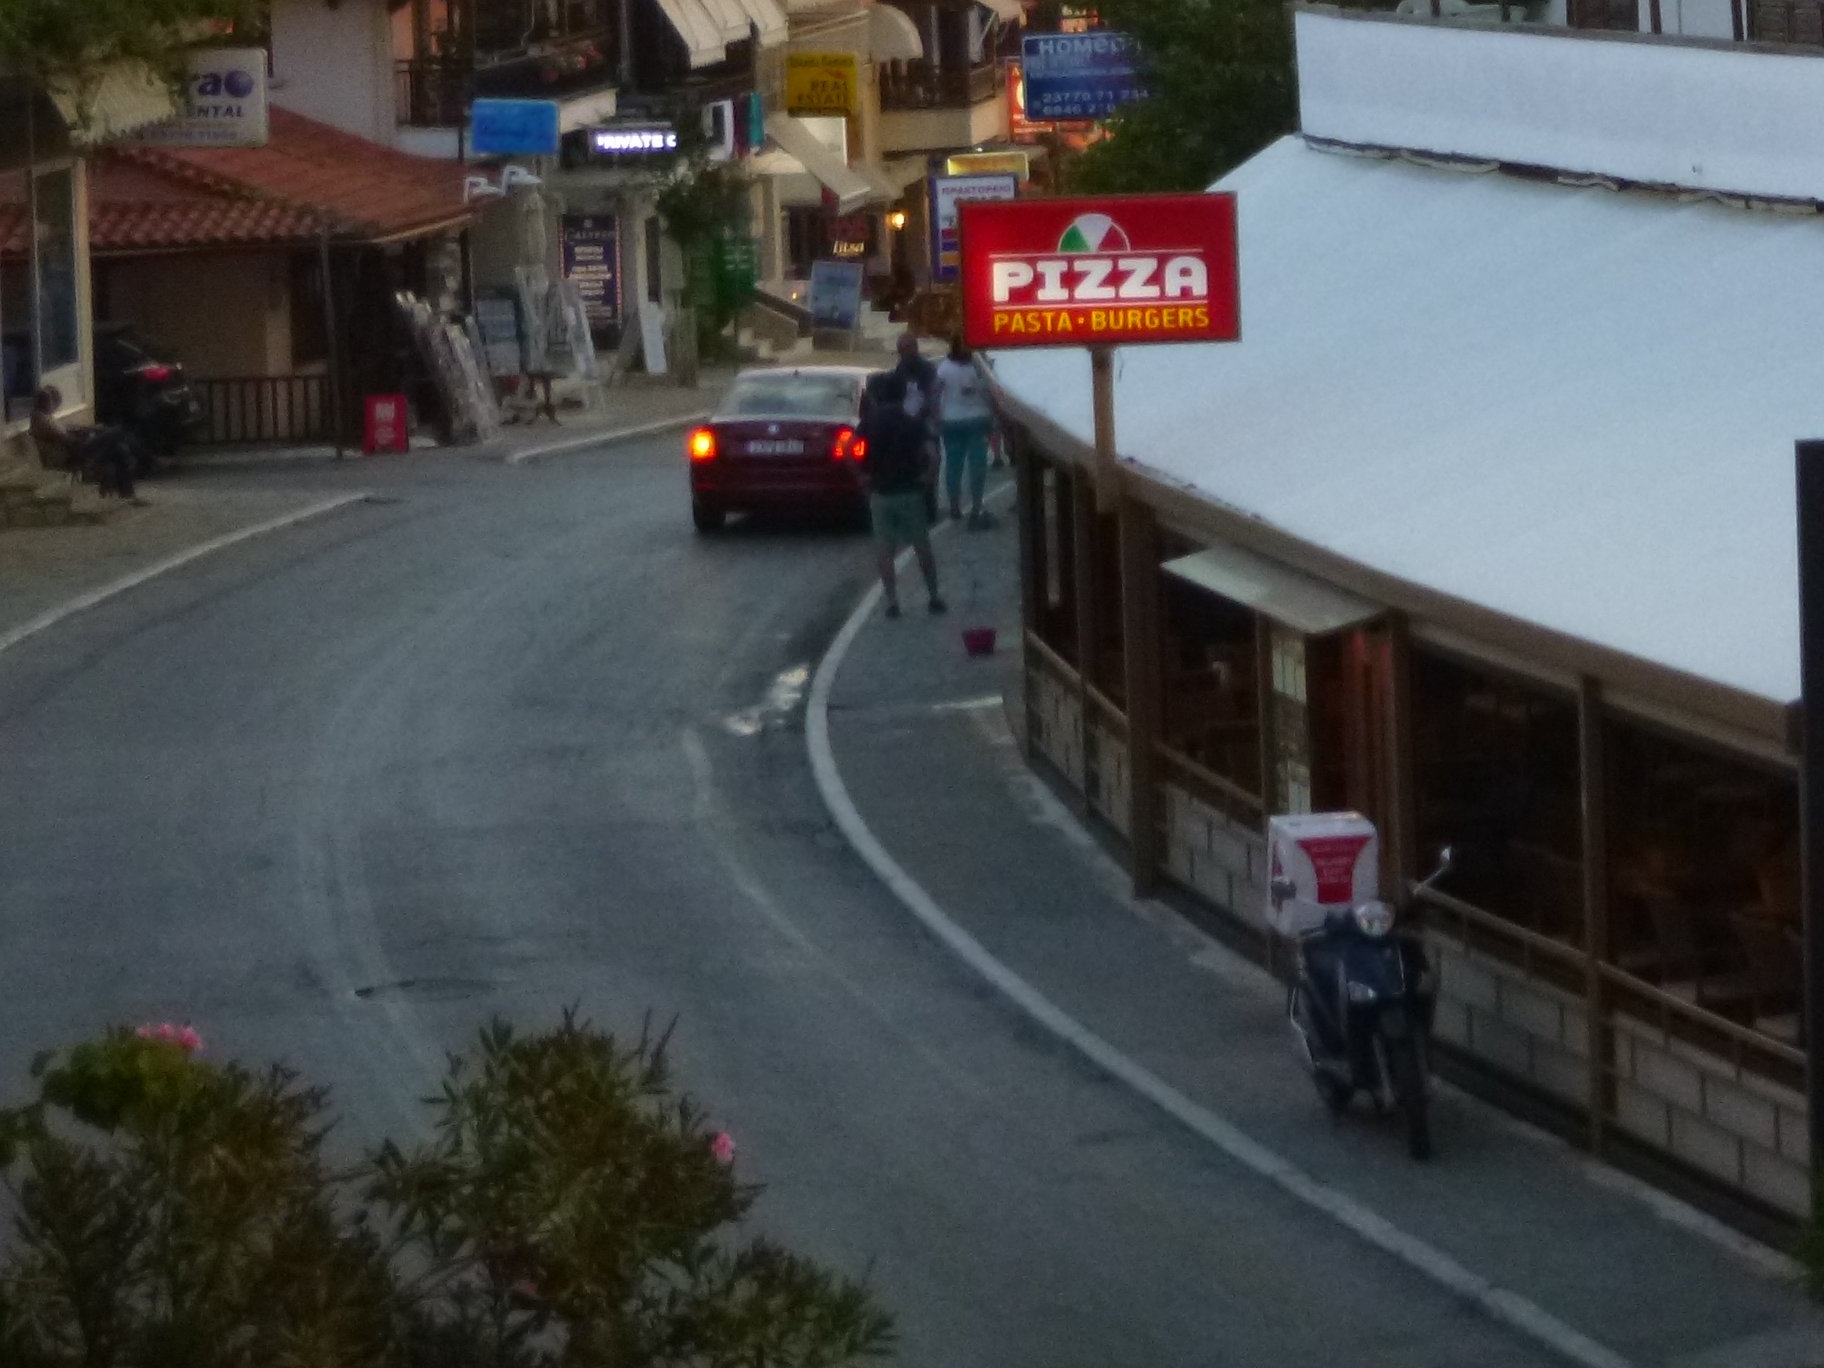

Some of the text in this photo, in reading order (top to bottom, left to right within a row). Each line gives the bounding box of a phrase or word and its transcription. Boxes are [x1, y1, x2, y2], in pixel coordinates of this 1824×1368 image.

[597, 134, 663, 149] PRIVATE
[993, 256, 1208, 302] PIZZA
[994, 308, 1210, 333] PASTA BURGERS
